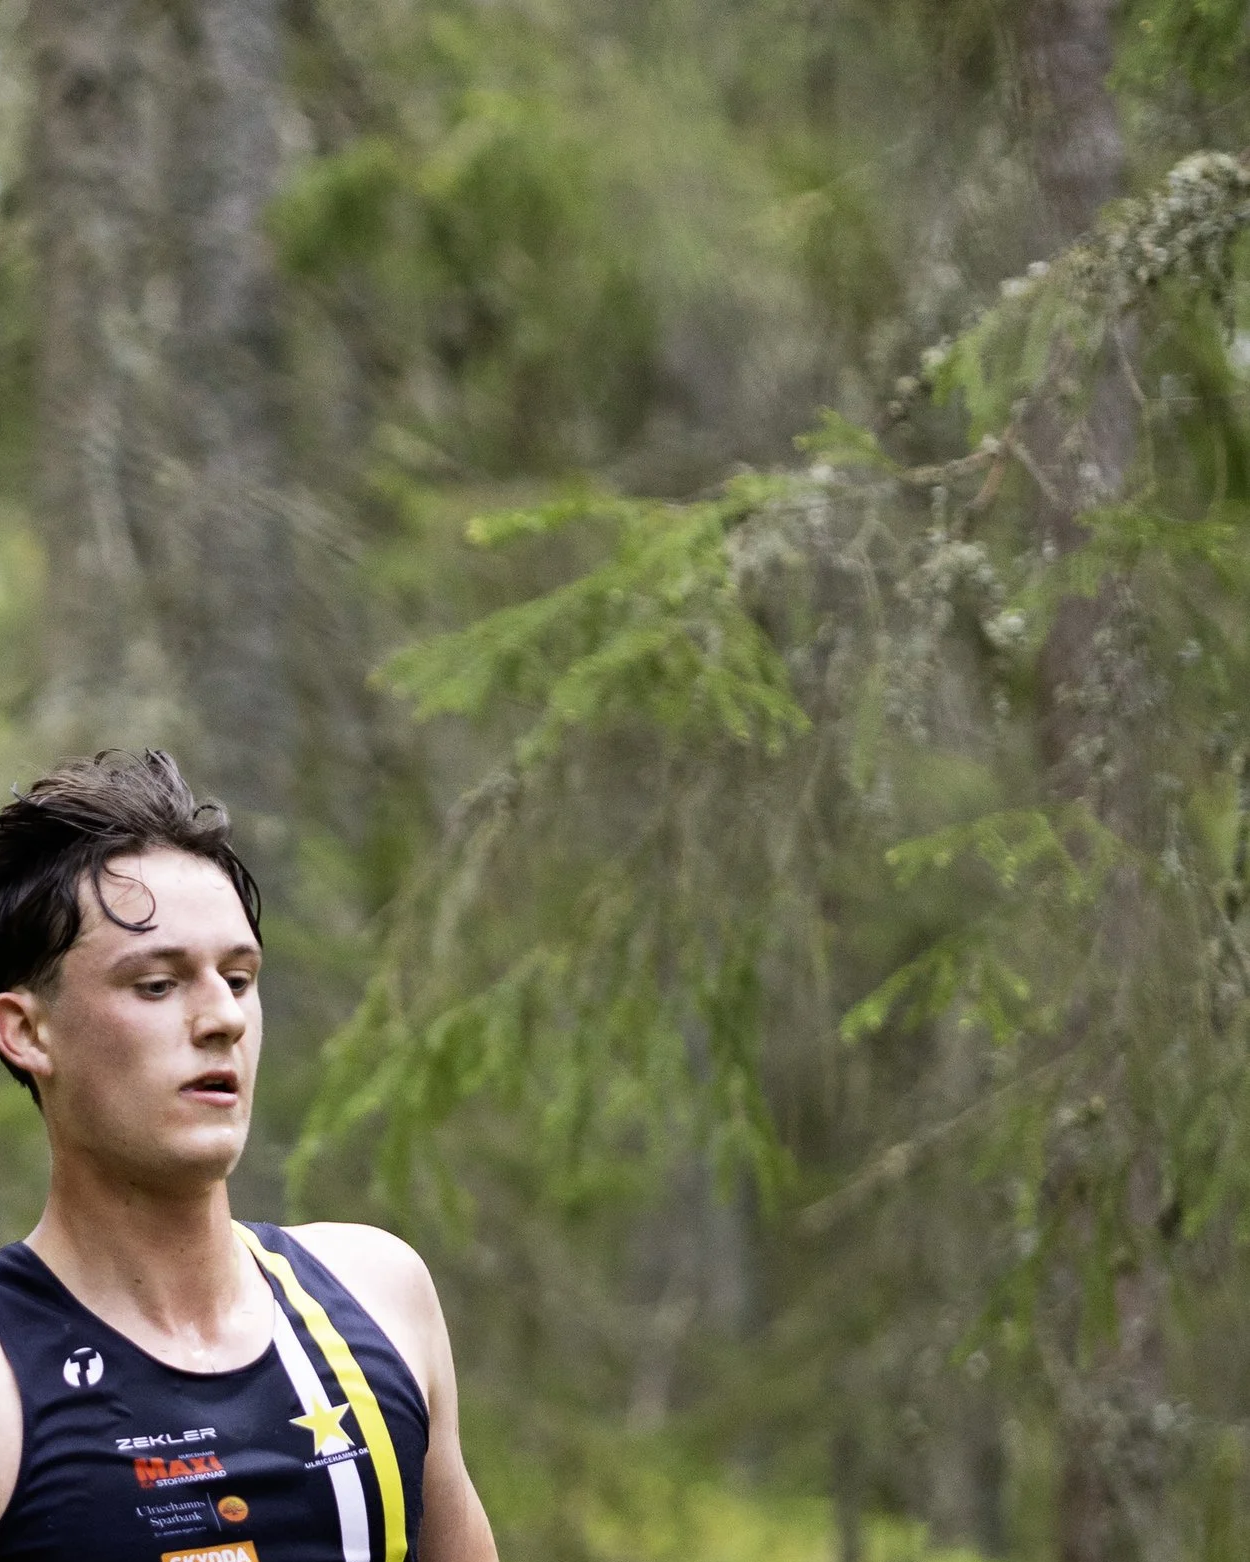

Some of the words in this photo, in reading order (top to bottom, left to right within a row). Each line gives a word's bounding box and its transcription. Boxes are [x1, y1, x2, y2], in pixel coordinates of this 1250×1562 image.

[115, 1427, 217, 1450] ZEKLER
[134, 1455, 223, 1481] MAXI
[304, 1452, 358, 1469] ULRICEHAMNS
[358, 1447, 369, 1456] OK
[155, 1469, 227, 1487] STORMARKNAD
[136, 1500, 206, 1517] Ulricehamns
[150, 1511, 203, 1528] Sparbank
